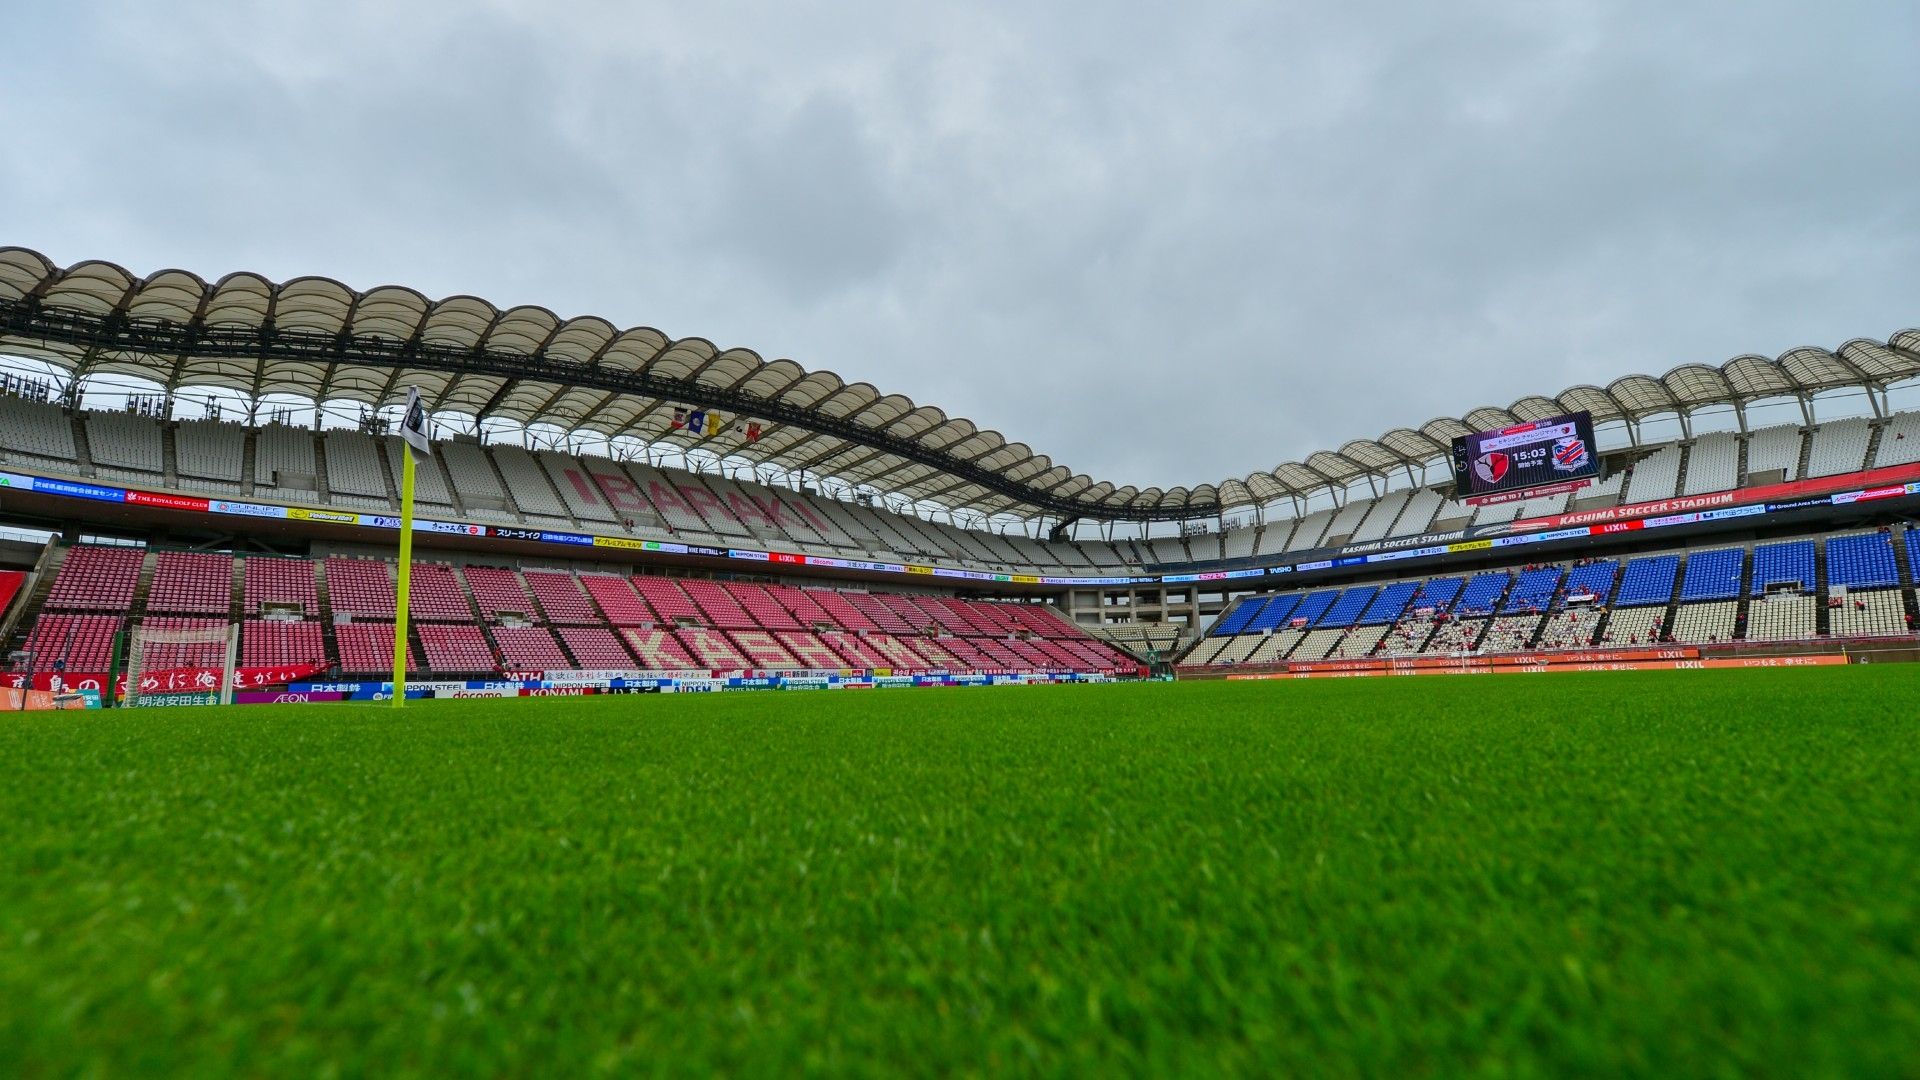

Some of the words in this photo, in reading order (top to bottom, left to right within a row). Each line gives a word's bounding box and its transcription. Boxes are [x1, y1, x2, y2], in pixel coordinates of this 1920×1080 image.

[1513, 448, 1547, 461] 15:03
[152, 497, 172, 505] ROYAL
[564, 467, 830, 532] IBARAKI
[1559, 509, 1615, 526] KASHIMA
[1618, 503, 1668, 518] SOCCER
[1671, 493, 1733, 510] STADIUM
[1604, 523, 1629, 532] LIXIL
[1546, 532, 1568, 540] NIPPON
[1570, 529, 1589, 537] STEEL
[1341, 542, 1381, 554] KASHIMA
[1383, 537, 1419, 549] SOCCER
[1421, 530, 1465, 544] STADIUM
[735, 551, 754, 559] NIPPON
[778, 554, 797, 563] LIXIL
[812, 558, 834, 566] docomo
[1657, 650, 1685, 659] LIXIL
[1396, 660, 1415, 668] LIXIL
[1514, 656, 1537, 664] LIXIL
[1675, 660, 1704, 669] LIXIL
[484, 682, 525, 690] 日本製鉄
[452, 690, 502, 699] docomo
[529, 689, 584, 697] KONAMI
[138, 695, 218, 707] 明治安田生命
